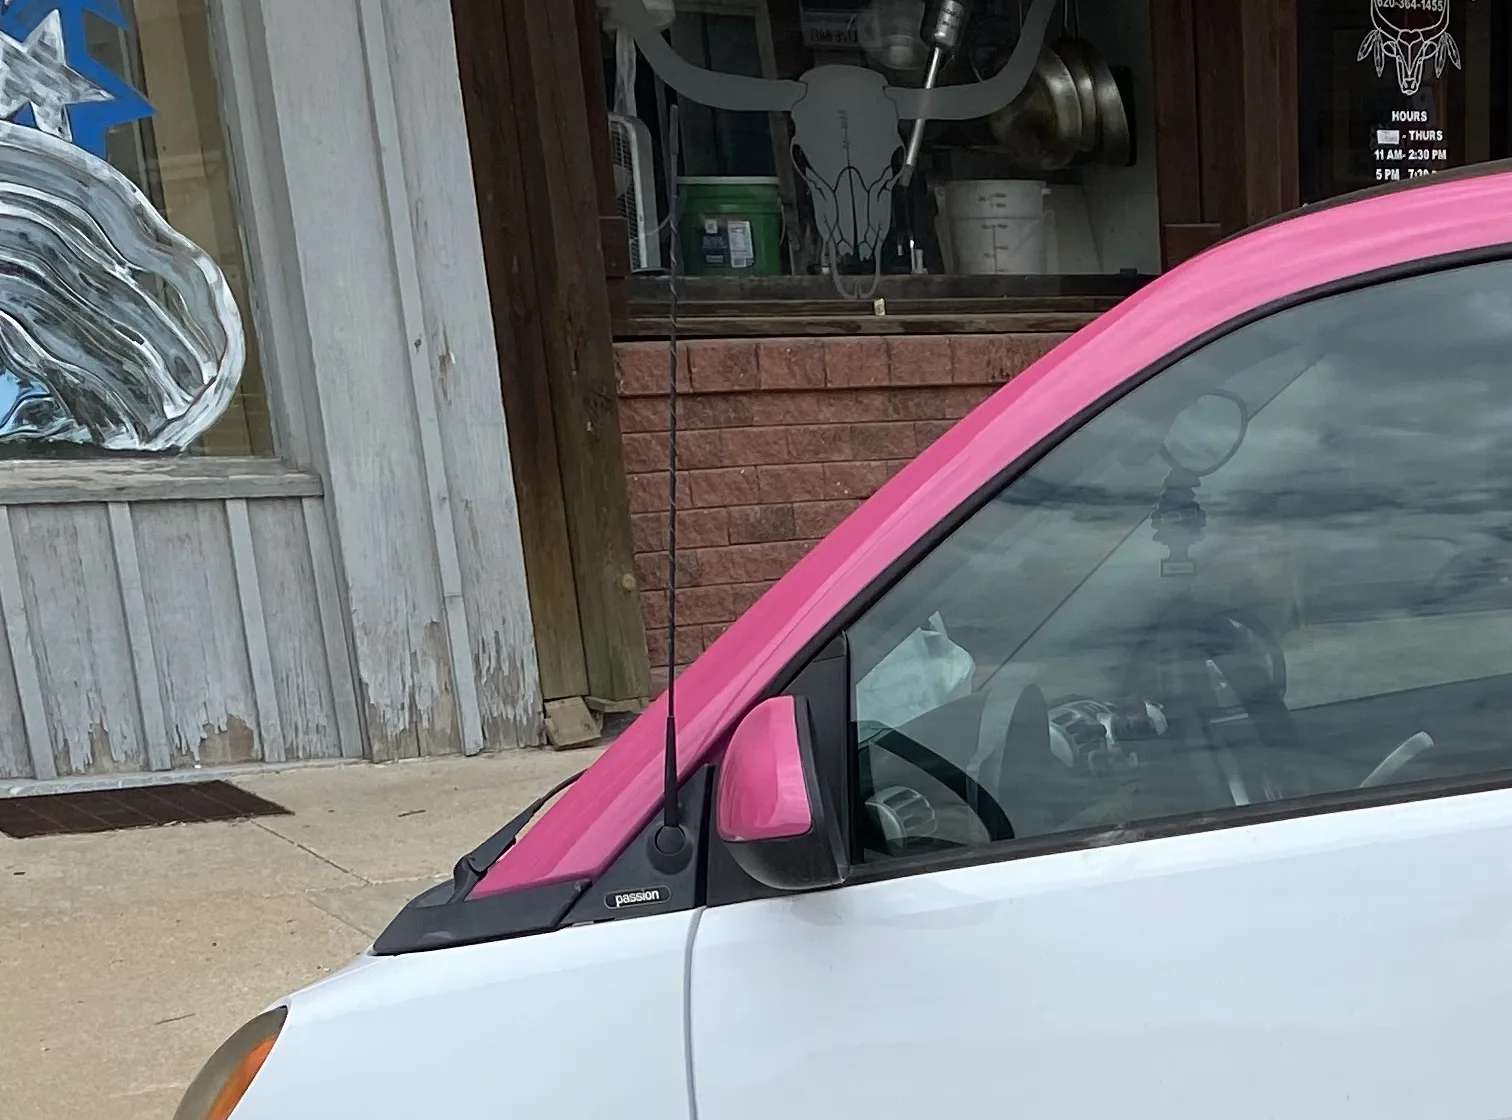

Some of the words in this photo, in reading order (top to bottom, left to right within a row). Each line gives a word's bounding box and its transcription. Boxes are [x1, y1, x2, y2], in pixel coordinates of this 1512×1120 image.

[1377, 0, 1444, 12] 620-364-1455
[1391, 110, 1428, 122] HOURS
[1408, 129, 1443, 141] THURS
[1374, 148, 1384, 160] 11
[1408, 149, 1430, 160] 2:30
[1431, 149, 1447, 160] PM
[1375, 168, 1383, 180] 5
[1384, 168, 1400, 180] PM
[615, 889, 660, 908] passion
